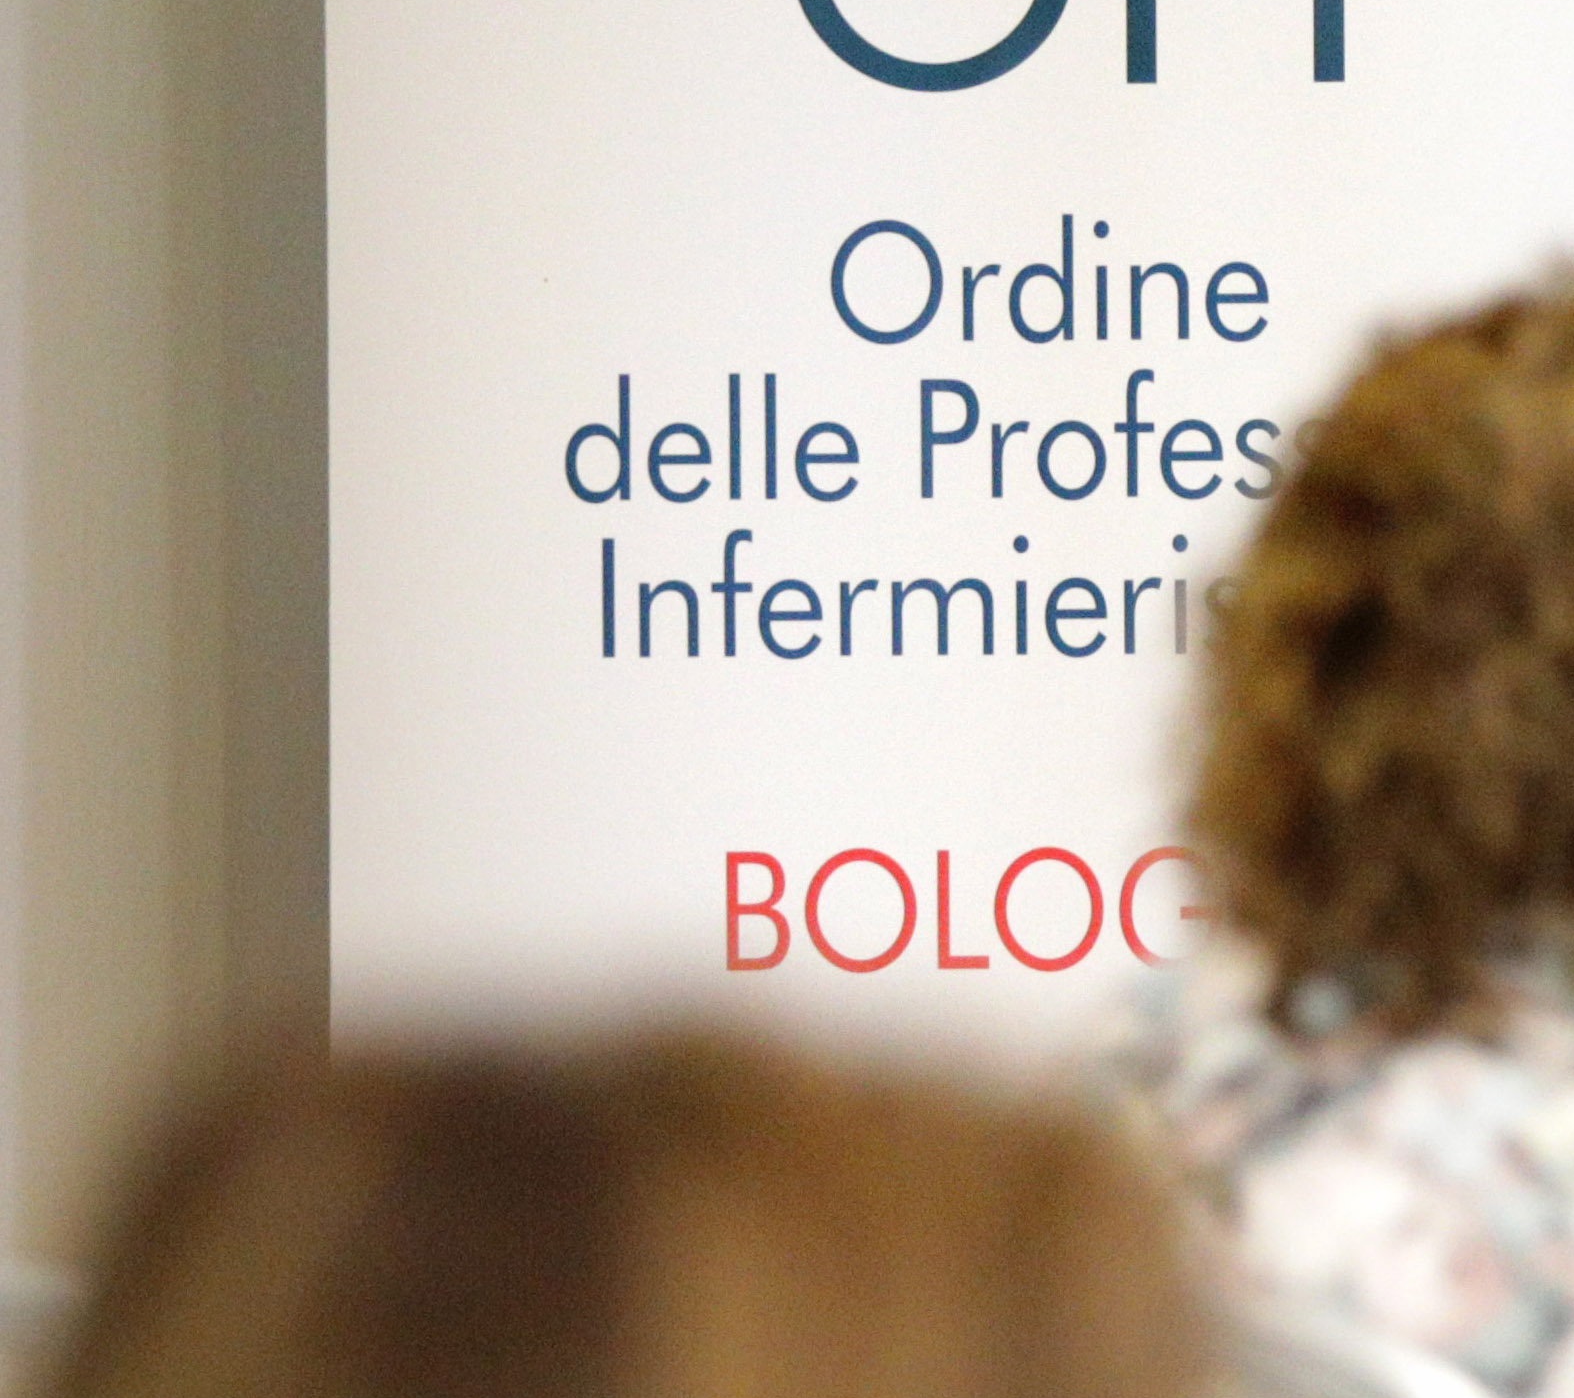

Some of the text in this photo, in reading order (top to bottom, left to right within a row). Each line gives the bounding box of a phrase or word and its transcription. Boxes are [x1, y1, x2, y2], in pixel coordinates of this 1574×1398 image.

[830, 214, 1271, 345] Ordine
[565, 368, 1290, 504] delle Profes
[602, 527, 1215, 660] Infermieri
[725, 846, 1210, 974] BOLOG
